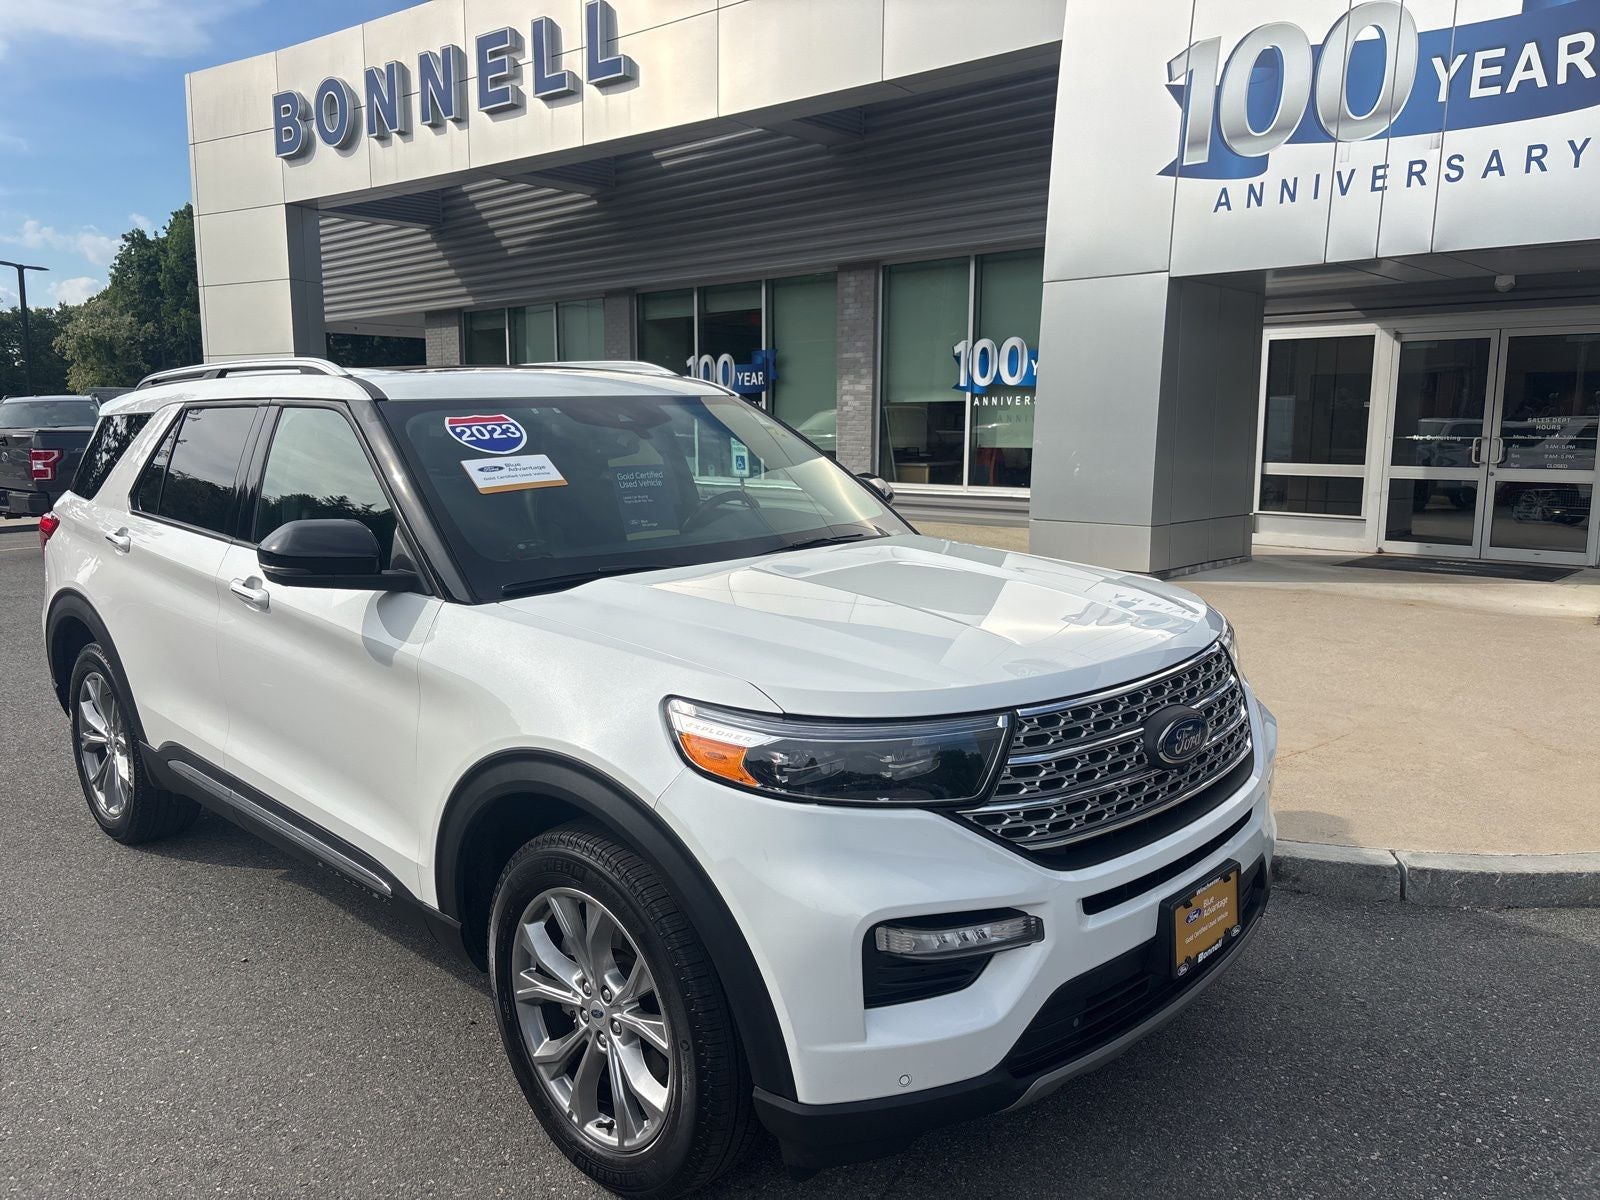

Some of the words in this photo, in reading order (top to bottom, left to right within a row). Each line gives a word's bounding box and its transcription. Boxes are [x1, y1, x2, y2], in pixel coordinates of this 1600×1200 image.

[273, 0, 631, 159] BONNELL
[1166, 0, 1419, 166] 100
[1431, 31, 1597, 103] YEAR
[1213, 137, 1592, 213] ANNIVERSARY
[686, 353, 735, 390] 100
[737, 371, 764, 386] YEAR
[954, 336, 1028, 387] 100
[456, 424, 521, 441] 2023
[508, 465, 547, 473] Advantage
[617, 472, 635, 480] Gold
[635, 471, 664, 479] Certified
[619, 480, 638, 489] Used
[638, 479, 663, 488] Vehicle
[1174, 724, 1202, 755] Ford
[1203, 896, 1215, 909] Blue
[1203, 897, 1228, 918] Advantage
[1197, 938, 1223, 963] Bonnell
